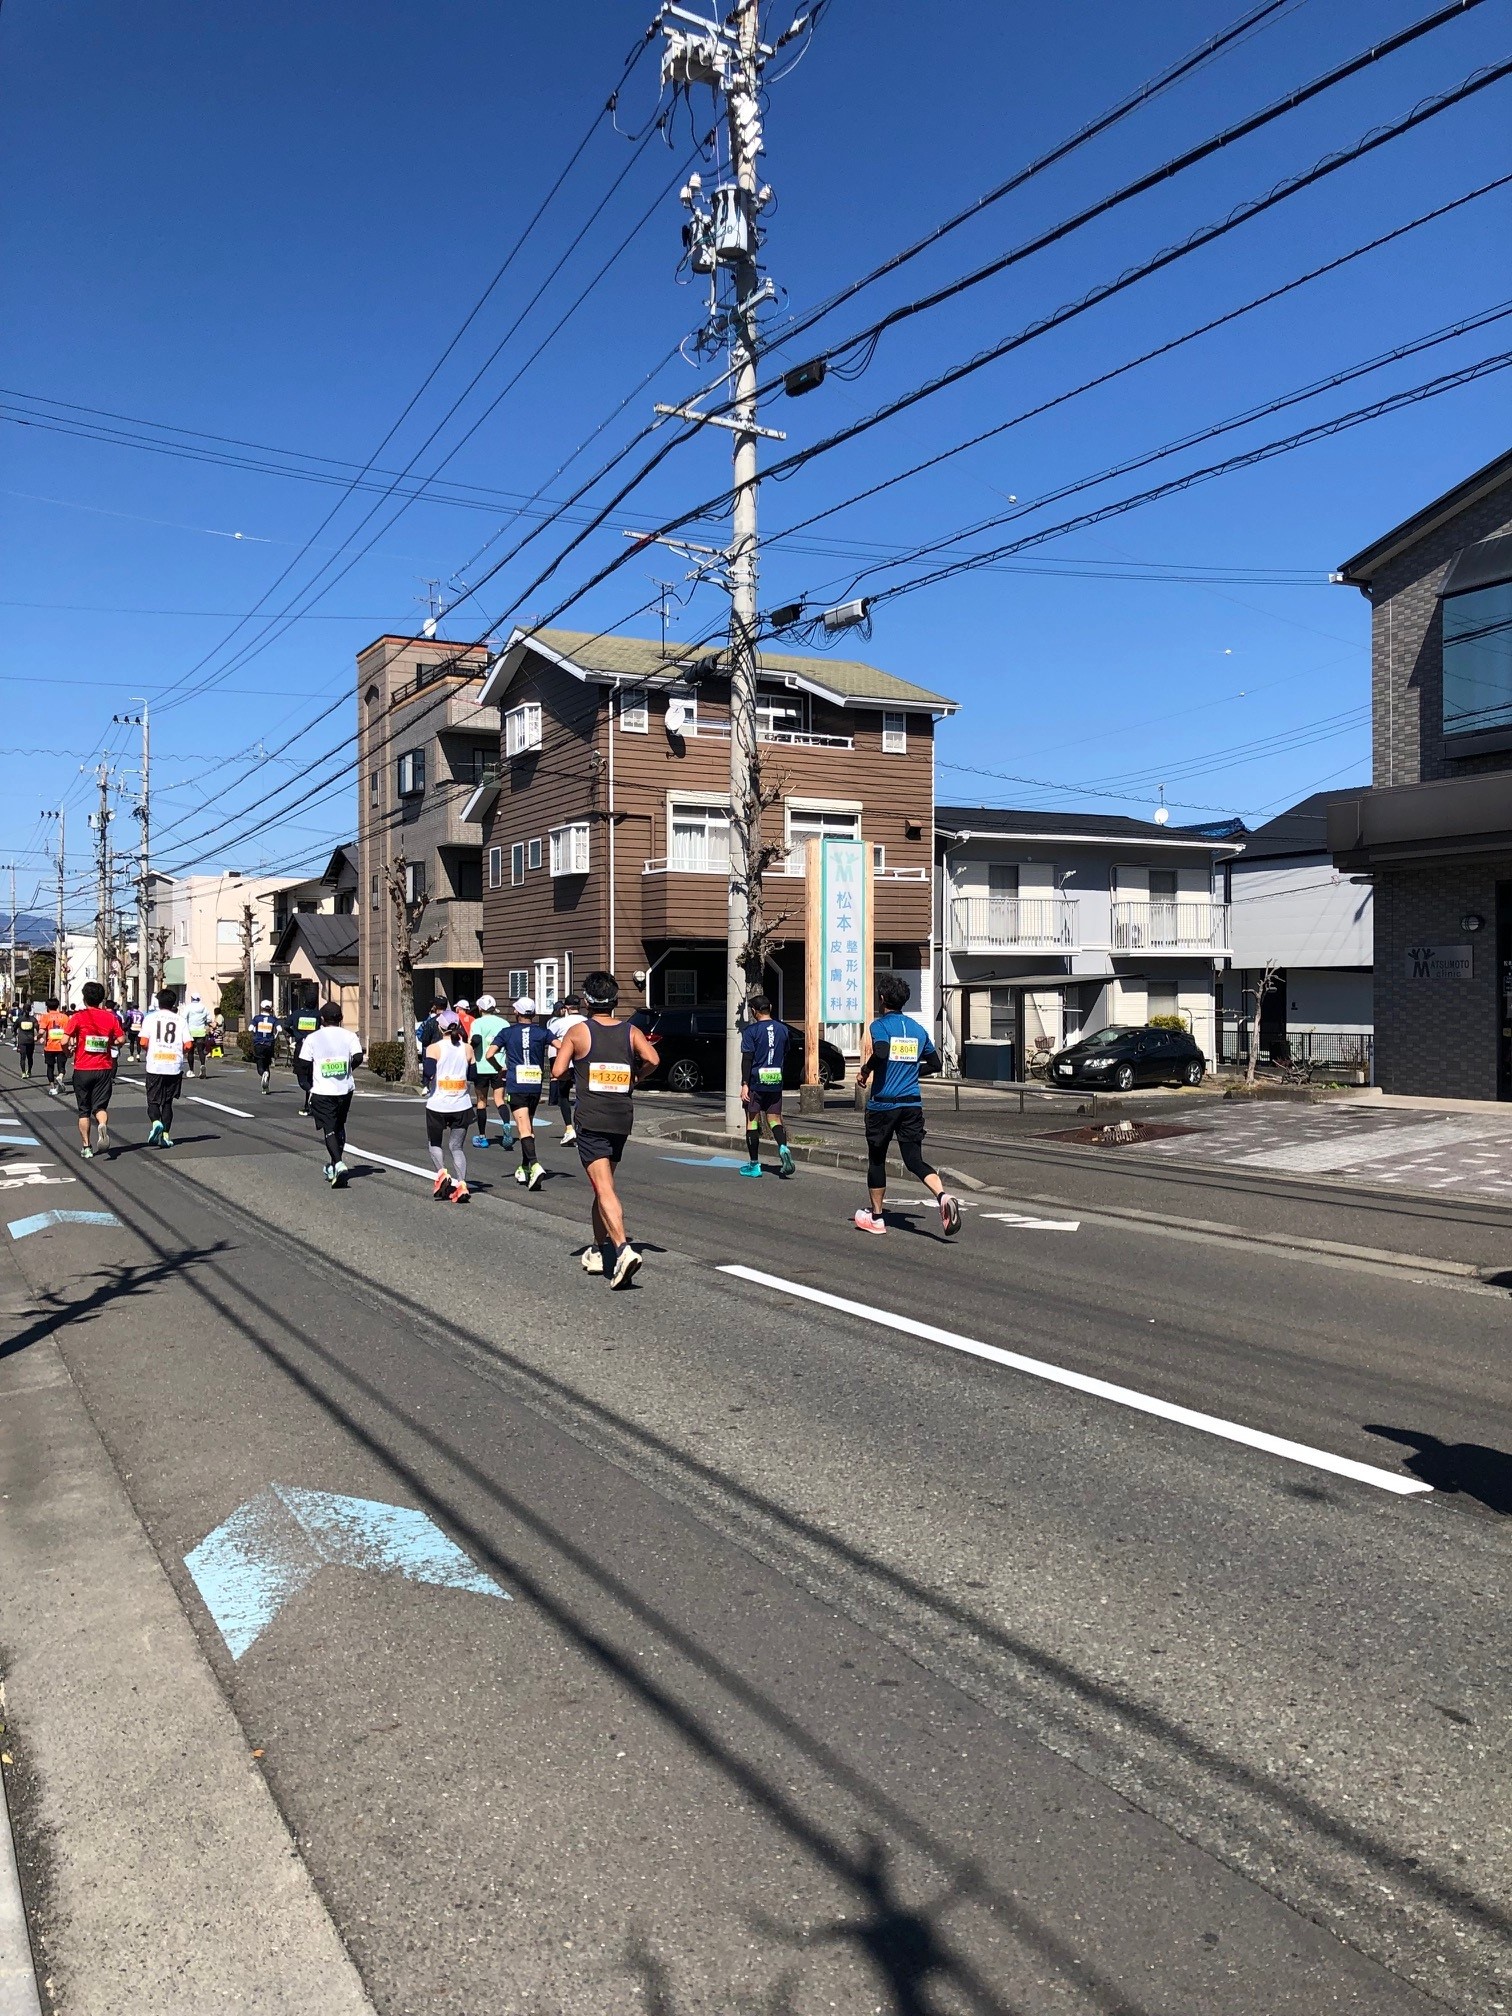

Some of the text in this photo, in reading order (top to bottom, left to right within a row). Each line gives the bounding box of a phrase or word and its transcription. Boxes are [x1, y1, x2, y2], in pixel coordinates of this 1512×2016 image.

[836, 891, 852, 932] 松本
[830, 940, 842, 1011] 皮膚科
[846, 940, 858, 1011] 整形外科
[156, 1020, 177, 1043] 18
[899, 1045, 917, 1054] 8041
[599, 1072, 629, 1083] 13267
